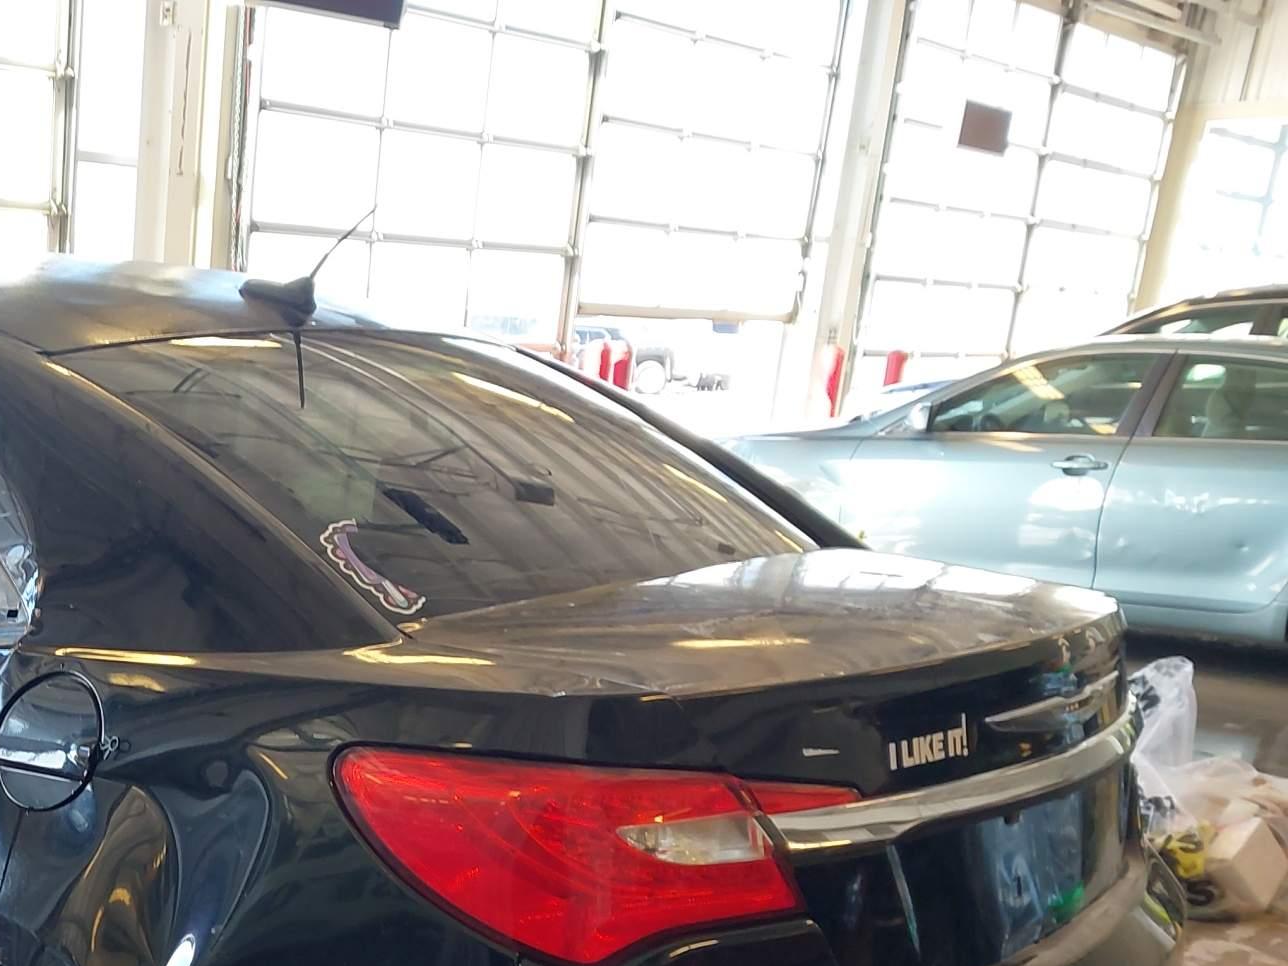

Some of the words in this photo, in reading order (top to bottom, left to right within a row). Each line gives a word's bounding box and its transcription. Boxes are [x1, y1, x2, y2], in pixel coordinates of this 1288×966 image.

[889, 742, 897, 770] I
[901, 732, 945, 768] LIKE
[947, 712, 968, 757] IT!
